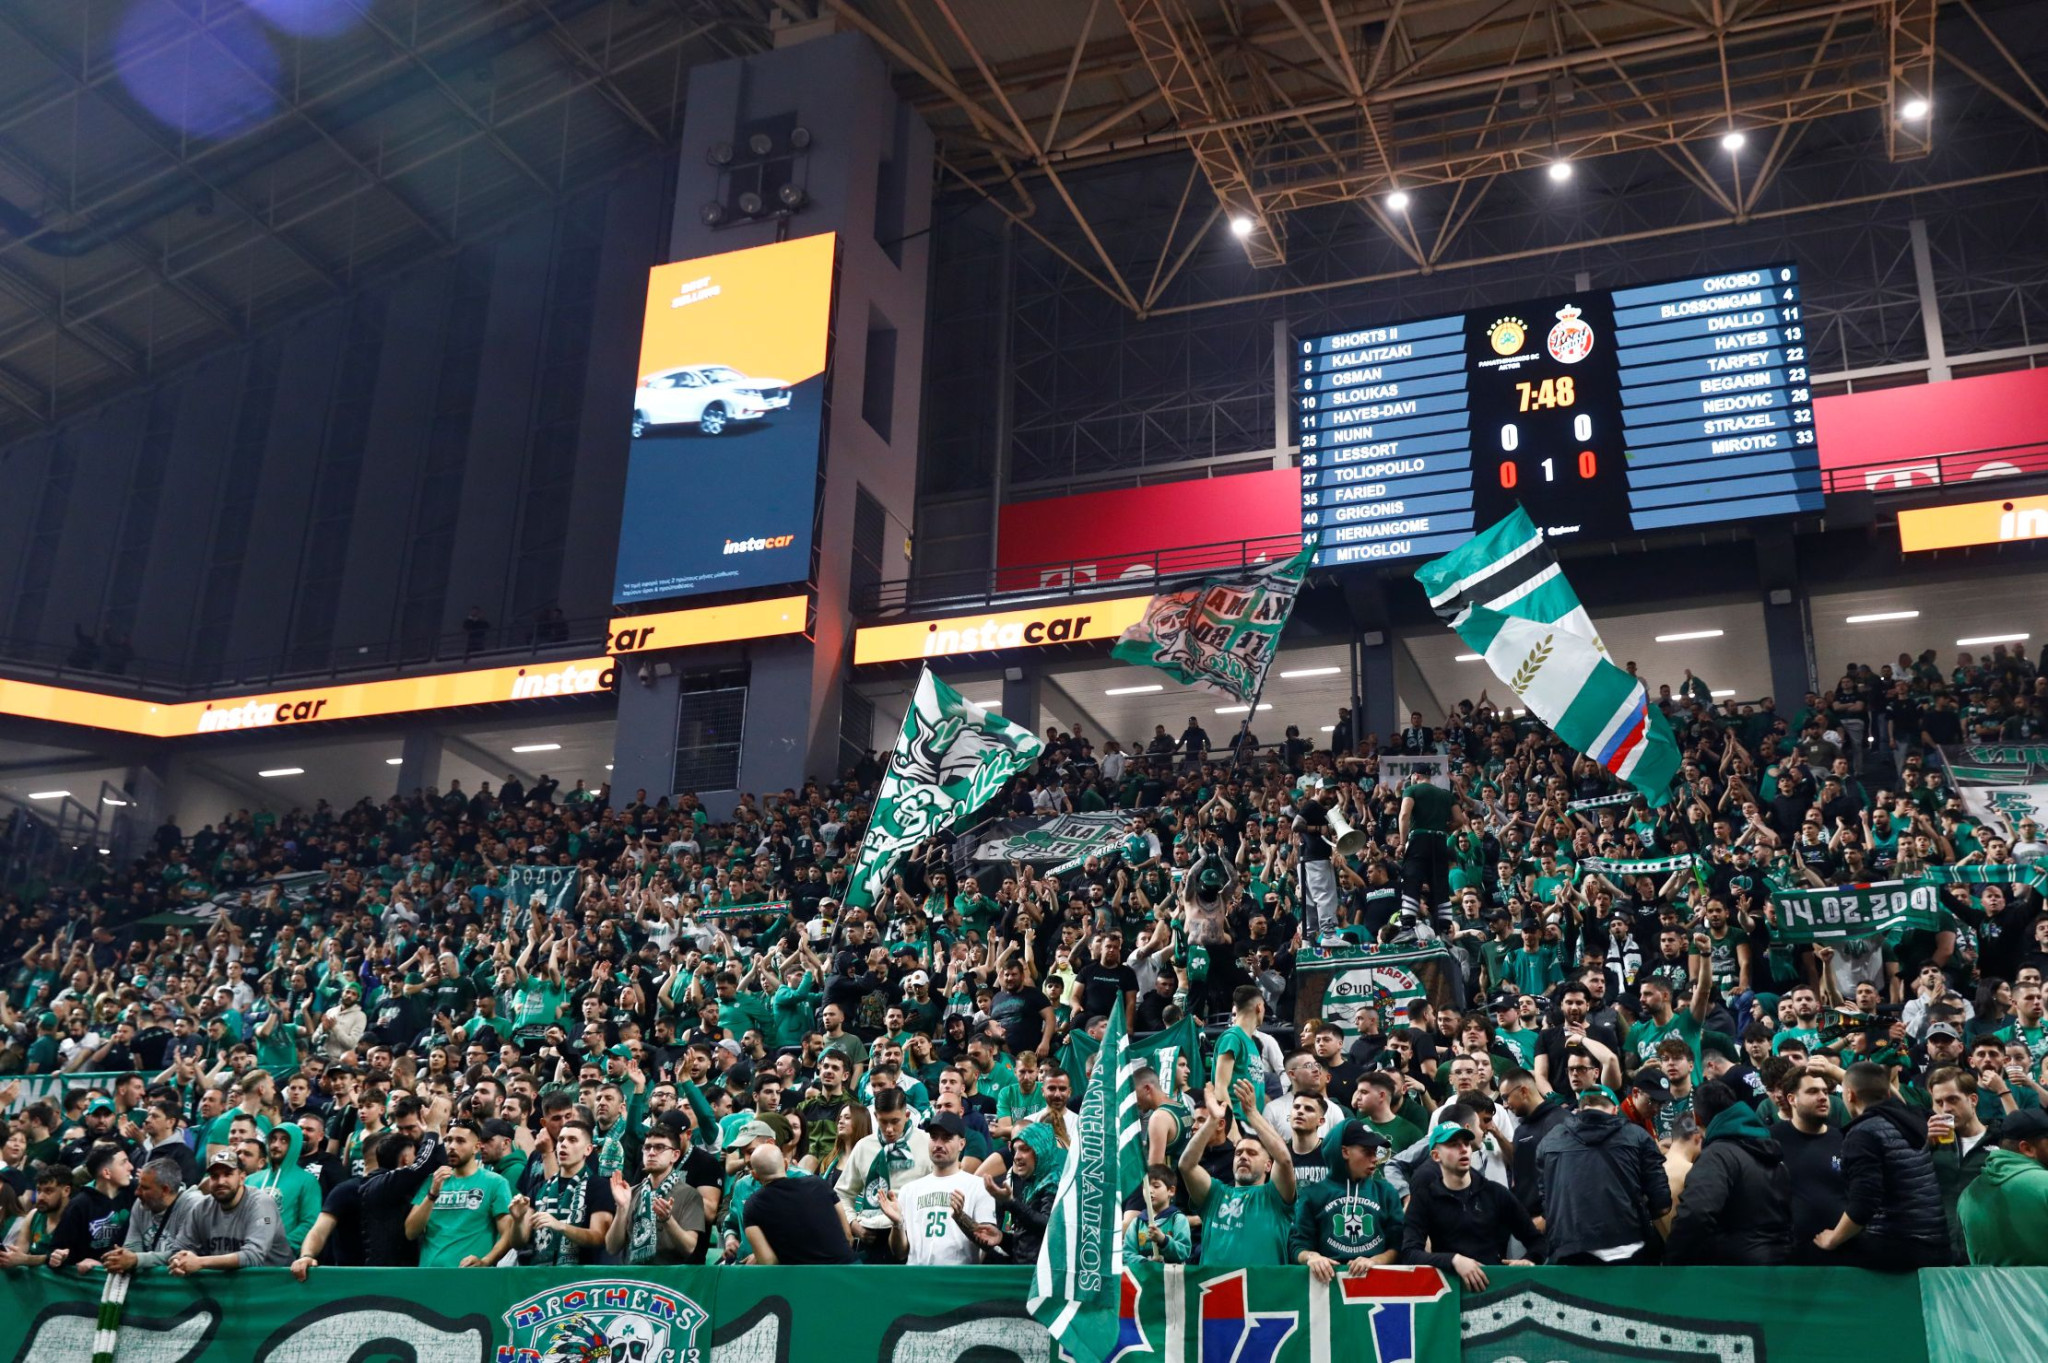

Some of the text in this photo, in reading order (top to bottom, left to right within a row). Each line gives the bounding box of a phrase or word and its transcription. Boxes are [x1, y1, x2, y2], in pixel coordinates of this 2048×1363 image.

[1703, 269, 1791, 292] OKOBO 0
[1661, 289, 1794, 318] BLOSSOMGAM 4
[1708, 308, 1799, 331] DIALLO 11
[1304, 328, 1398, 353] 0 SHORTS II
[1715, 328, 1801, 350] HAYES 13
[1304, 345, 1412, 371] 5 KALAITZAKI
[1707, 348, 1804, 371] TARPEY 22
[1304, 368, 1382, 390] 6 OSMAN
[1700, 368, 1806, 393] BEGARIN 23
[1302, 385, 1398, 409] 10 SLOUKAS
[1516, 376, 1574, 412] 7:48
[1703, 393, 1773, 413] NEDOVIC
[1302, 401, 1416, 428] 11 HAYES-DAVI
[1704, 409, 1811, 434] STRAZEL 32
[1302, 427, 1372, 447] 25 NUNN
[1501, 424, 1518, 451] 0
[1574, 414, 1592, 442] 0
[1302, 443, 1398, 466] 26 LESSORT
[1712, 430, 1813, 454] MIROTIC 33
[1303, 459, 1424, 486] 27 TOLIOPOULO
[1500, 461, 1517, 488] 0
[1541, 458, 1554, 482] 1
[1579, 451, 1596, 478] 0
[1303, 485, 1386, 506] 35 FARIED
[1304, 501, 1404, 525] 40 GRIGONIS
[724, 534, 794, 555] instacar
[1304, 520, 1430, 545] 41 HERNANGOME
[1336, 542, 1411, 561] MITOGLOU
[924, 614, 1091, 656] instacar
[197, 698, 328, 733] instacar
[1780, 886, 1937, 926] 14.02.2001
[1377, 967, 1413, 990] RAPID
[925, 1211, 947, 1238] 25
[515, 1287, 697, 1330] BROTHERS
